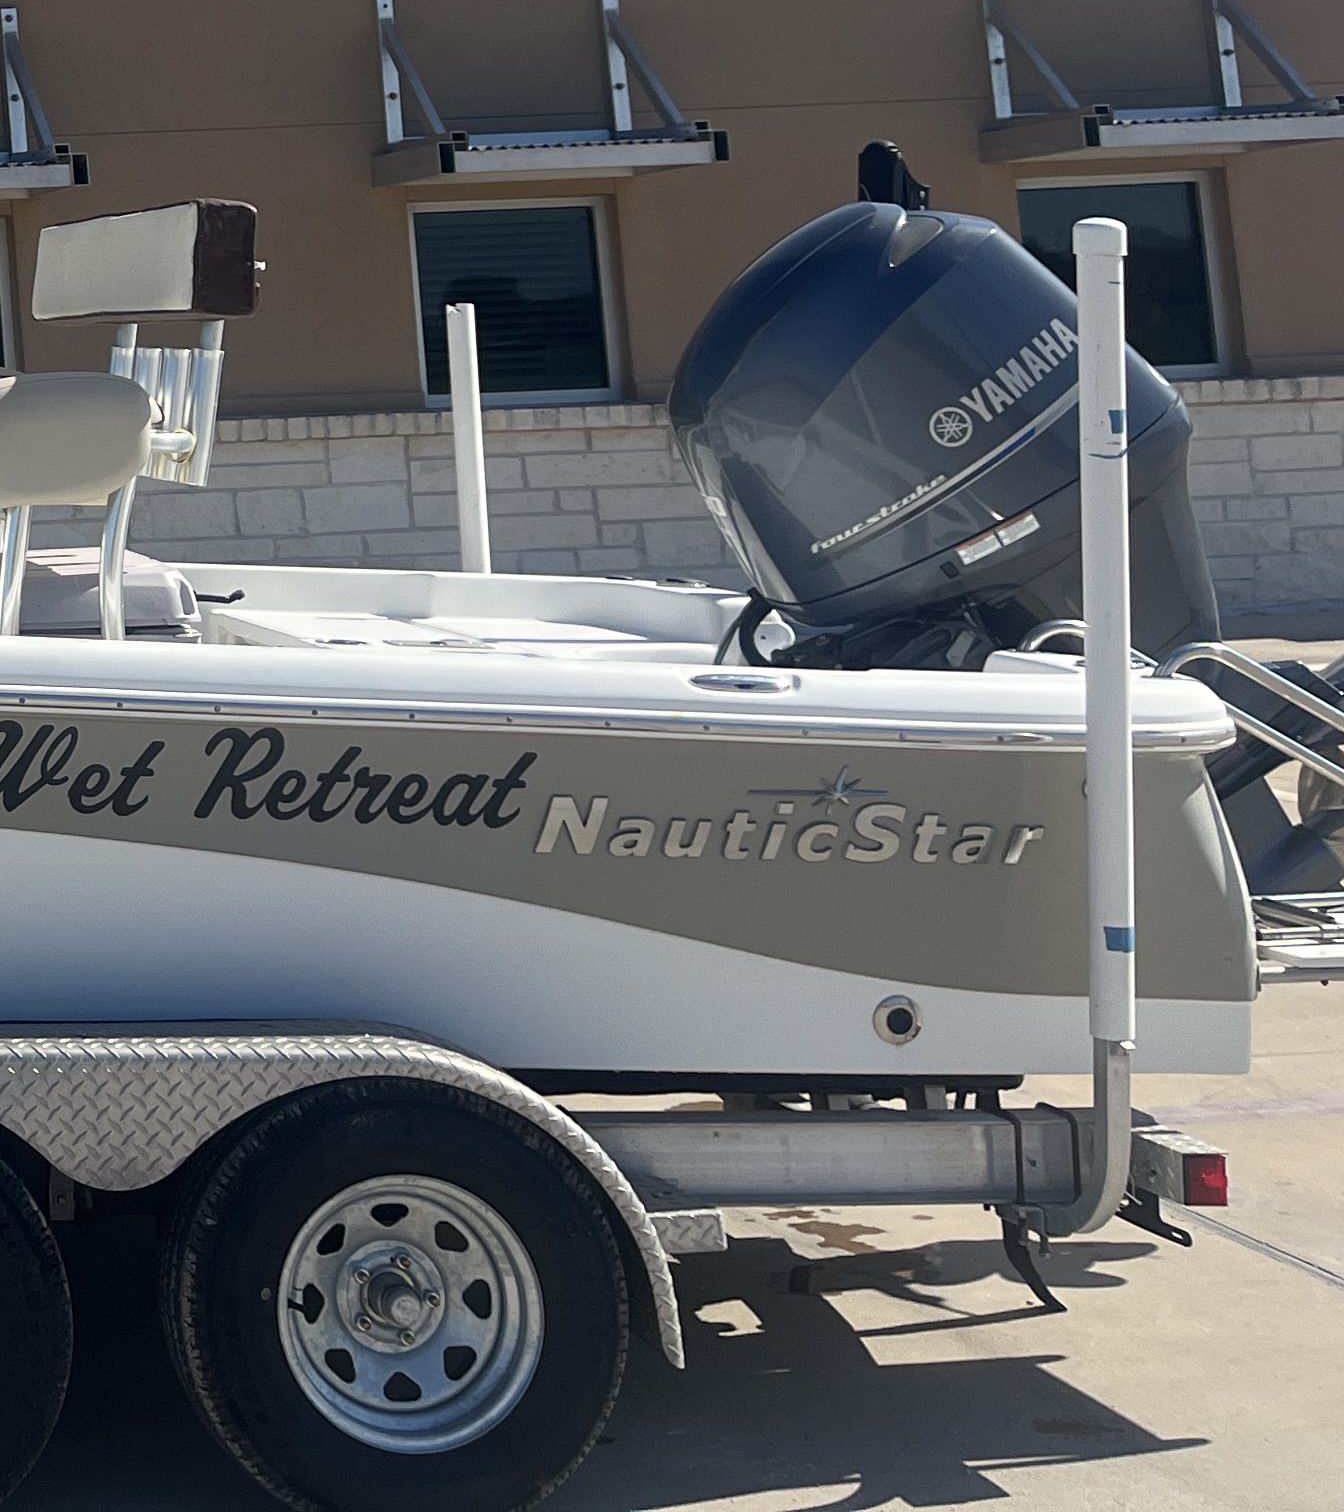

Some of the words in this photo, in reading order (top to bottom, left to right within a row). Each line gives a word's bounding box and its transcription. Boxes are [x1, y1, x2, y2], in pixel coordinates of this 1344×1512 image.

[960, 317, 1081, 423] YAMAHA
[194, 726, 538, 829] Retreat
[533, 794, 1045, 865] NauticStar
